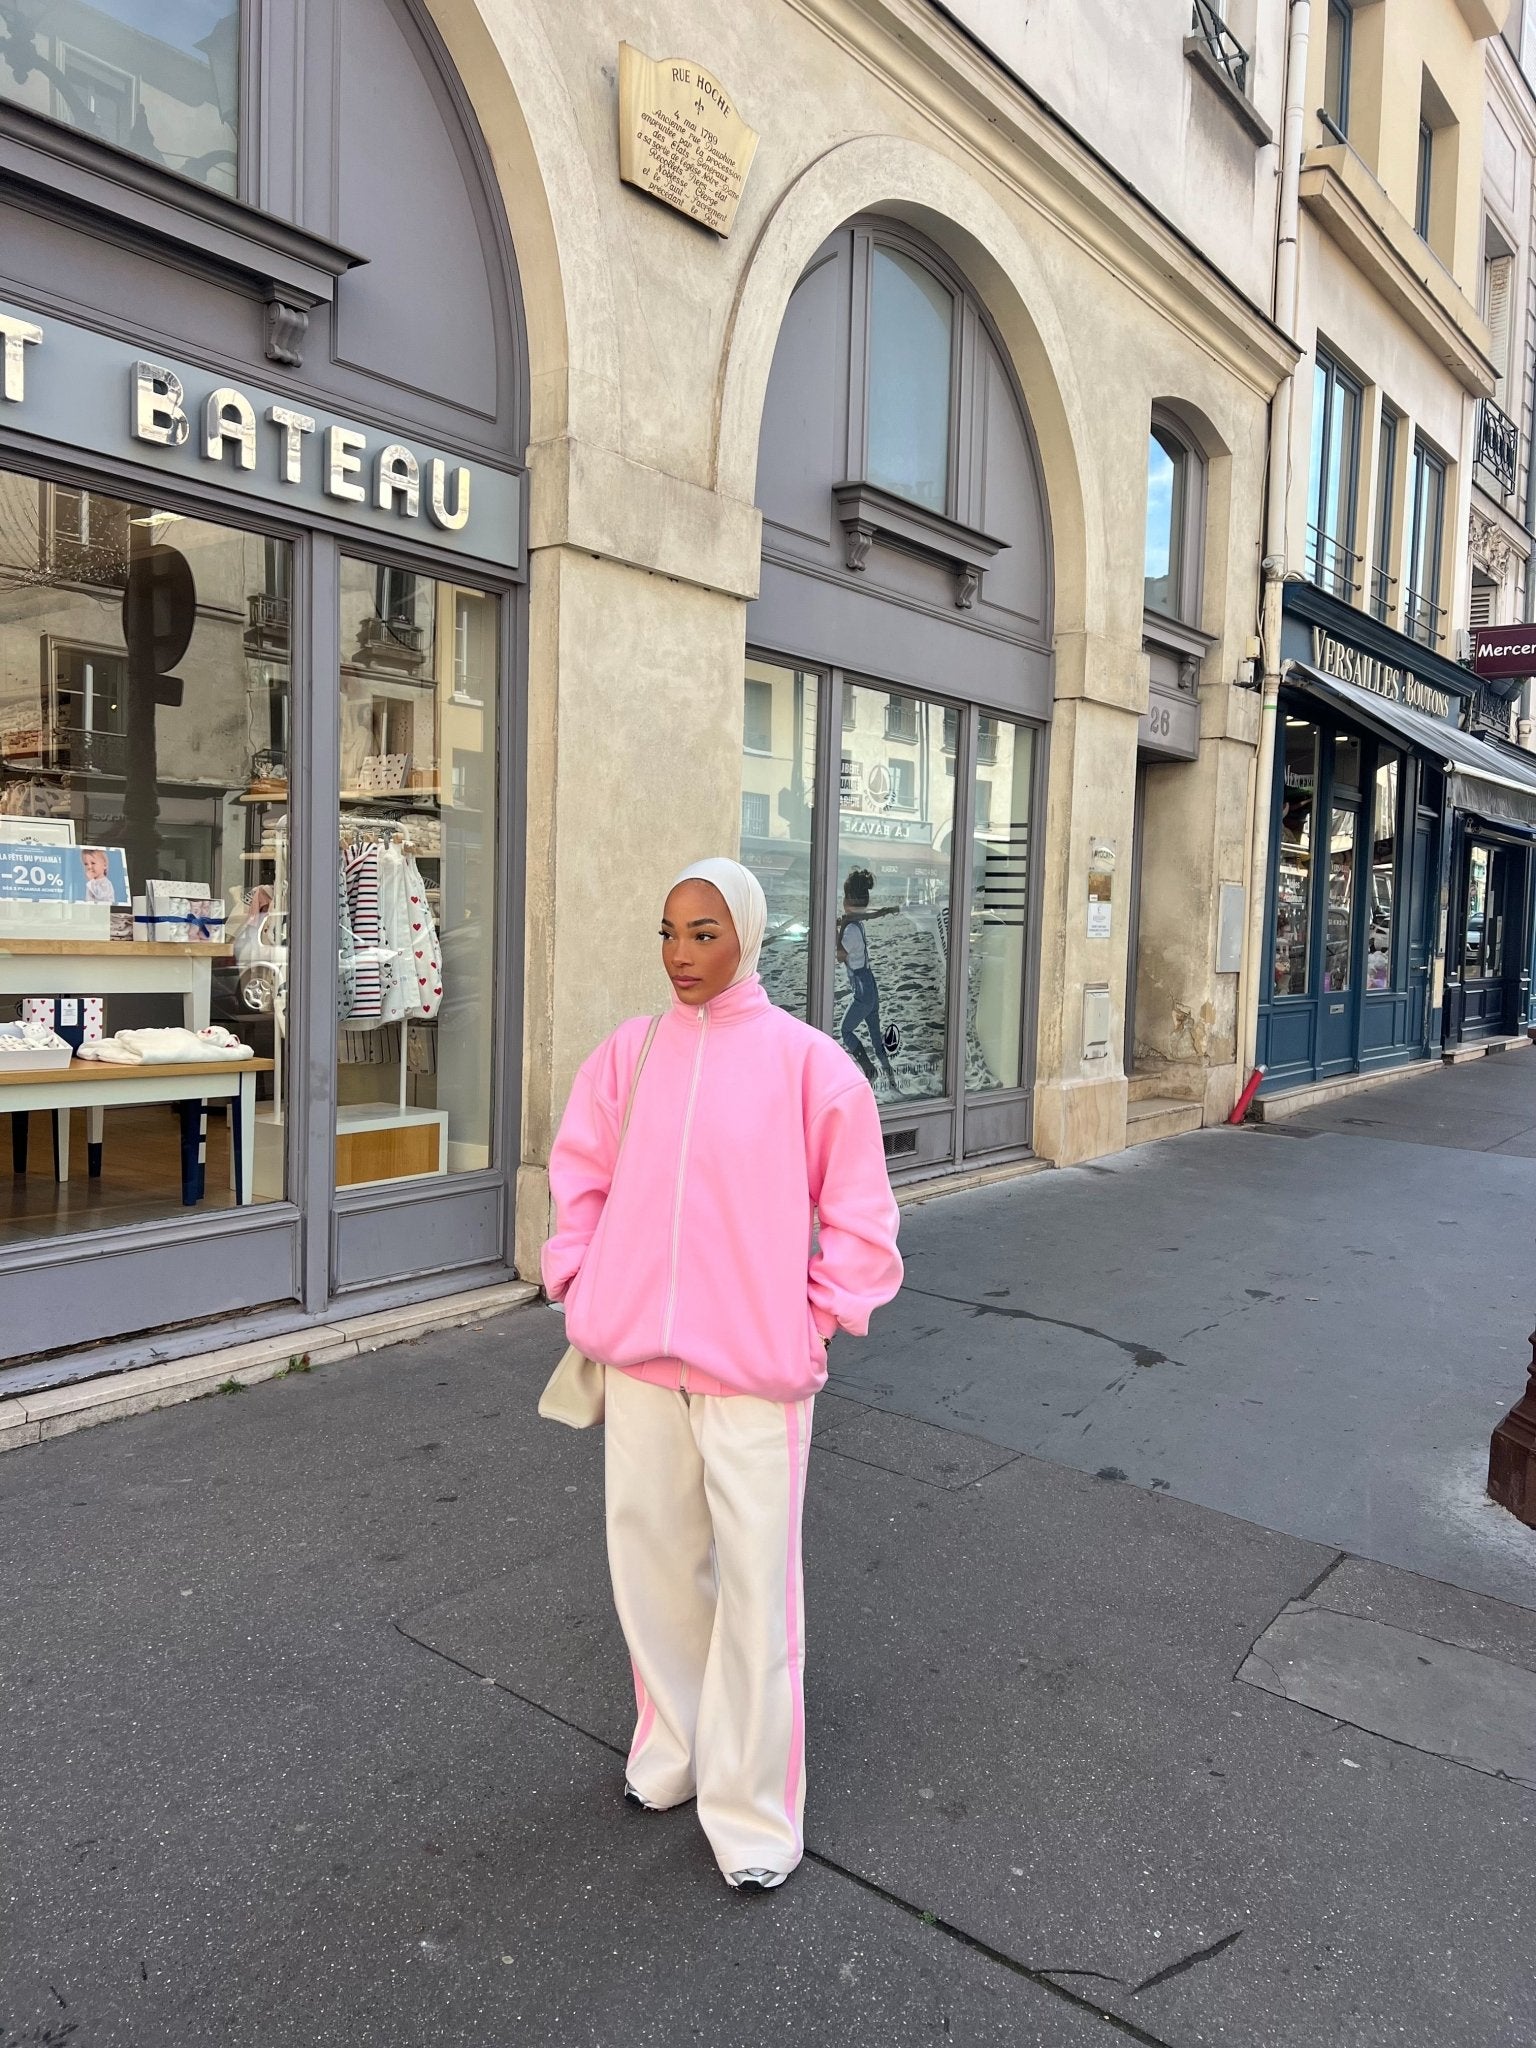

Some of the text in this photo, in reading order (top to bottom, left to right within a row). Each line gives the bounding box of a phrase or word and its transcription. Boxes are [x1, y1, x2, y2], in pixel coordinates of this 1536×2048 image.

[671, 67, 731, 119] RUE HOCHE
[652, 129, 666, 143] des
[652, 109, 736, 167] Ancienne rue Dauphine
[674, 110, 718, 145] 4 mai 1789
[651, 141, 671, 157] sortie
[671, 152, 680, 162] de
[679, 137, 693, 149] par
[695, 146, 704, 157] la
[706, 155, 742, 182] procession
[642, 167, 651, 176] et
[653, 171, 662, 182] le
[656, 163, 689, 189] Noblesse
[691, 205, 699, 215] le
[704, 213, 719, 227] Roi
[130, 359, 471, 531] BATEAU
[1478, 643, 1536, 658] Mercer
[1312, 625, 1450, 718] VERSAILLES BOUTONS
[1, 865, 64, 886] -20%
